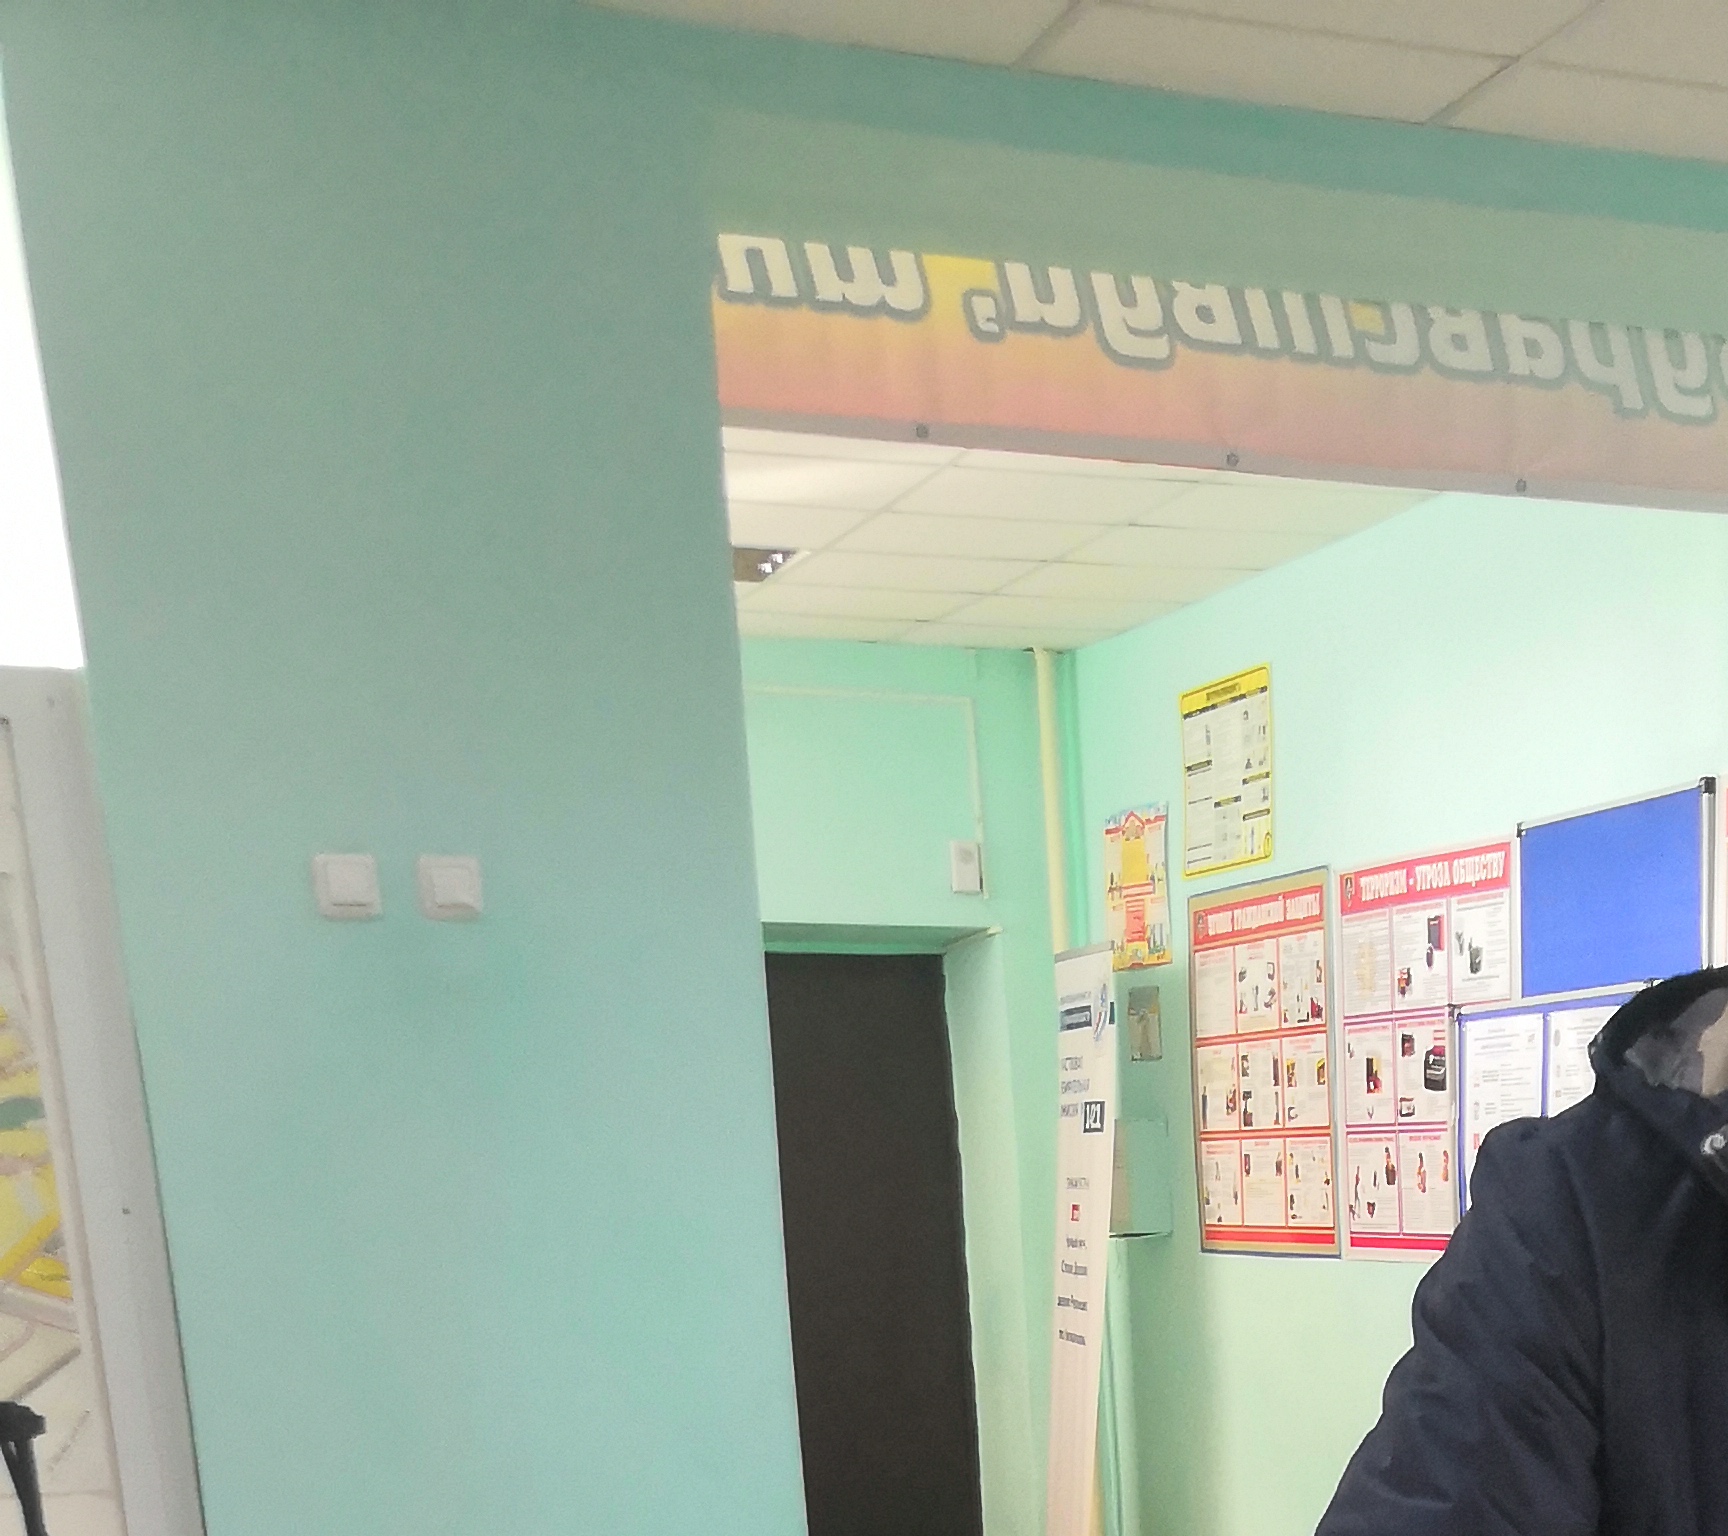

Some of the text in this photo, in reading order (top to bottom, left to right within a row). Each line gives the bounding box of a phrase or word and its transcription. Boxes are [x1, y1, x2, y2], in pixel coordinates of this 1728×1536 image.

[1359, 868, 1408, 902] ТЕРРОРИЗМ
[1414, 860, 1450, 892] УГРОЗА
[1452, 850, 1506, 888] ОБЩЕСТВУ
